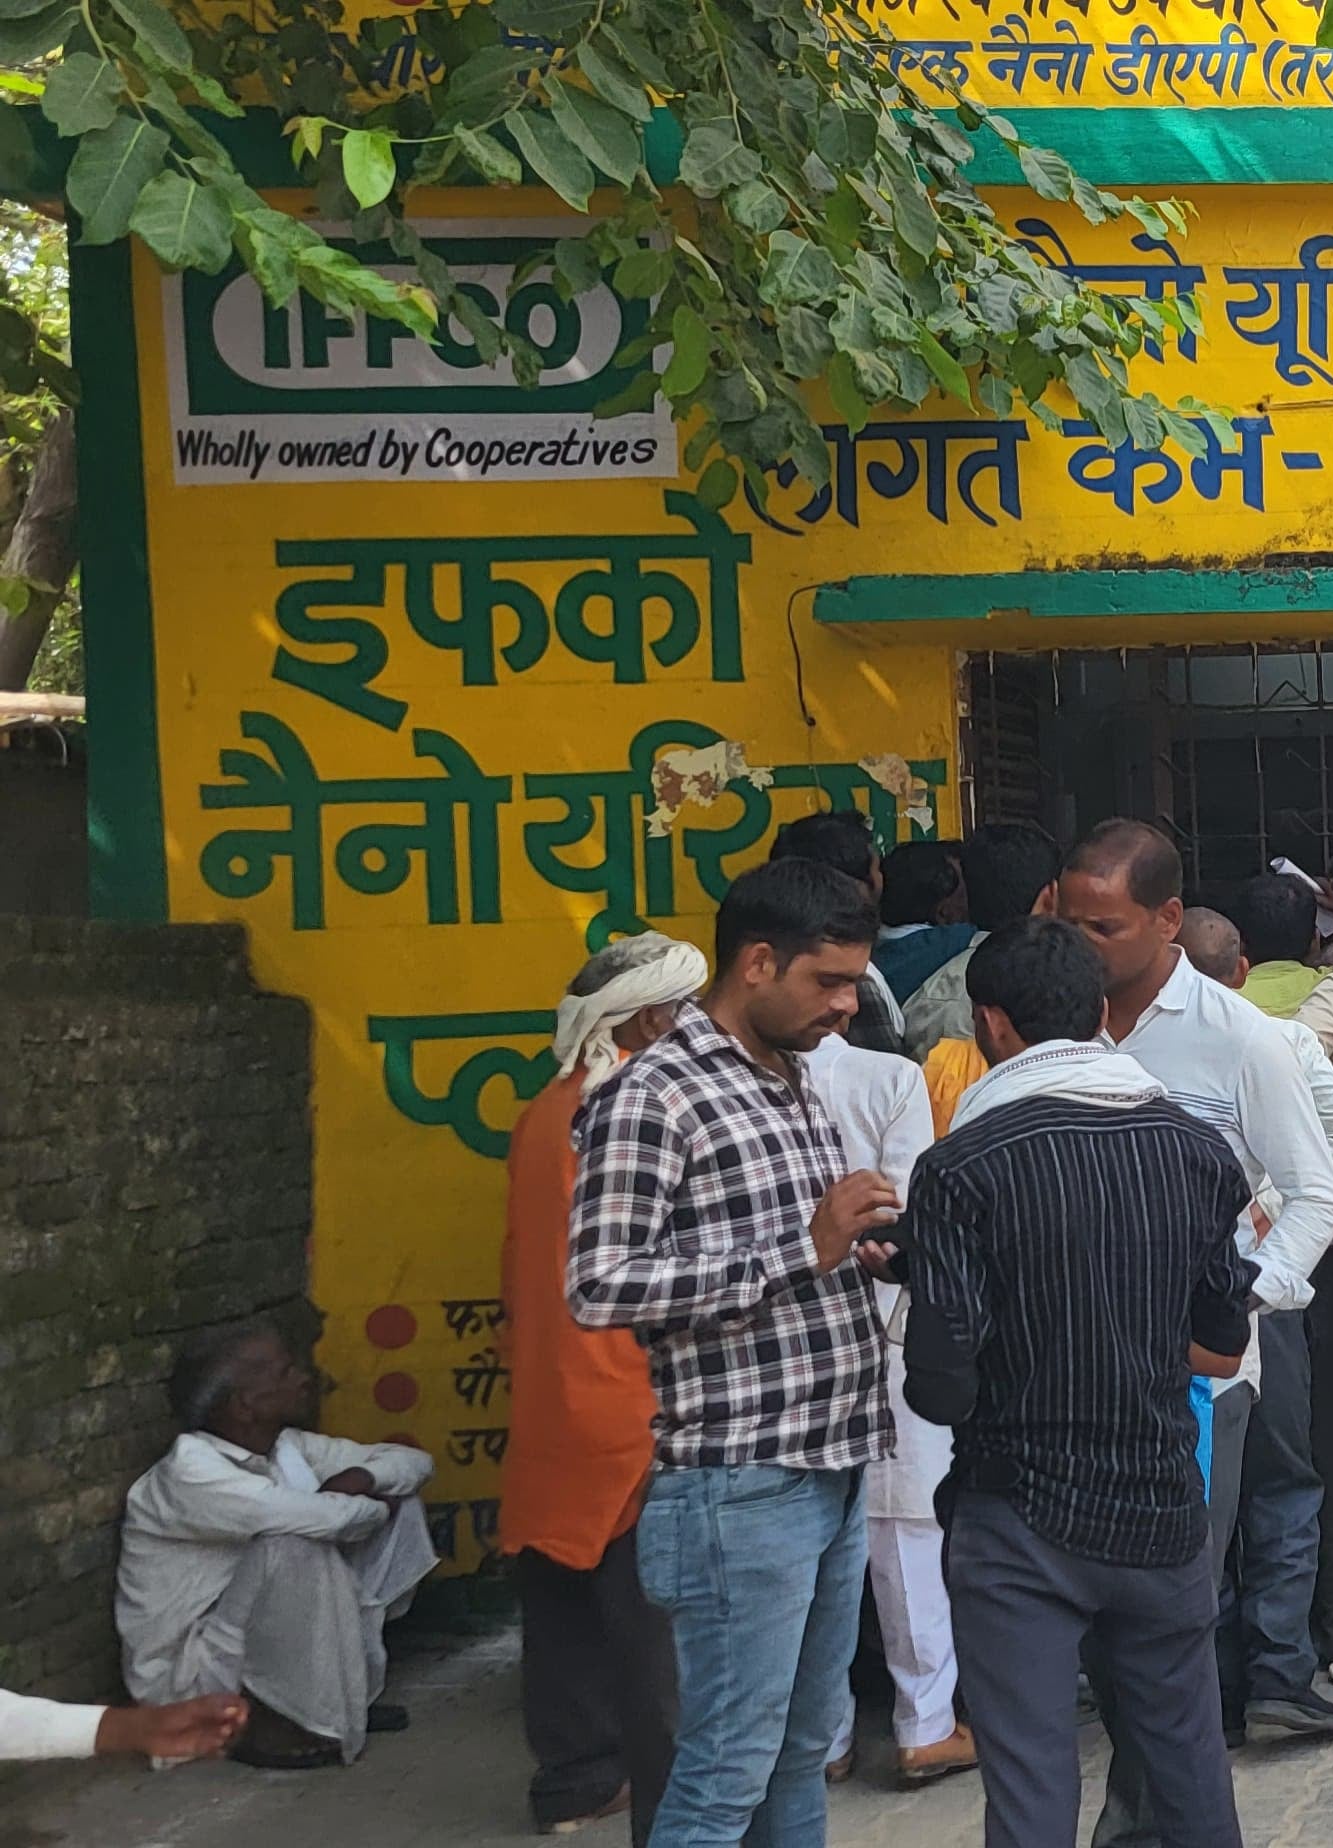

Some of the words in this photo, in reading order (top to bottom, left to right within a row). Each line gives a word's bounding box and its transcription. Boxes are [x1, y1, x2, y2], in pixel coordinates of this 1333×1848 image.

[980, 14, 1094, 97] नैनो
[1102, 24, 1256, 103] डीएपी
[177, 427, 270, 479] Wholly
[279, 433, 371, 467] owned
[377, 428, 419, 475] by
[424, 426, 658, 474] Cooperatives
[742, 418, 1030, 536] लागत
[1060, 415, 1274, 517] कम
[272, 489, 753, 731] इफको
[200, 711, 513, 931] नैनो
